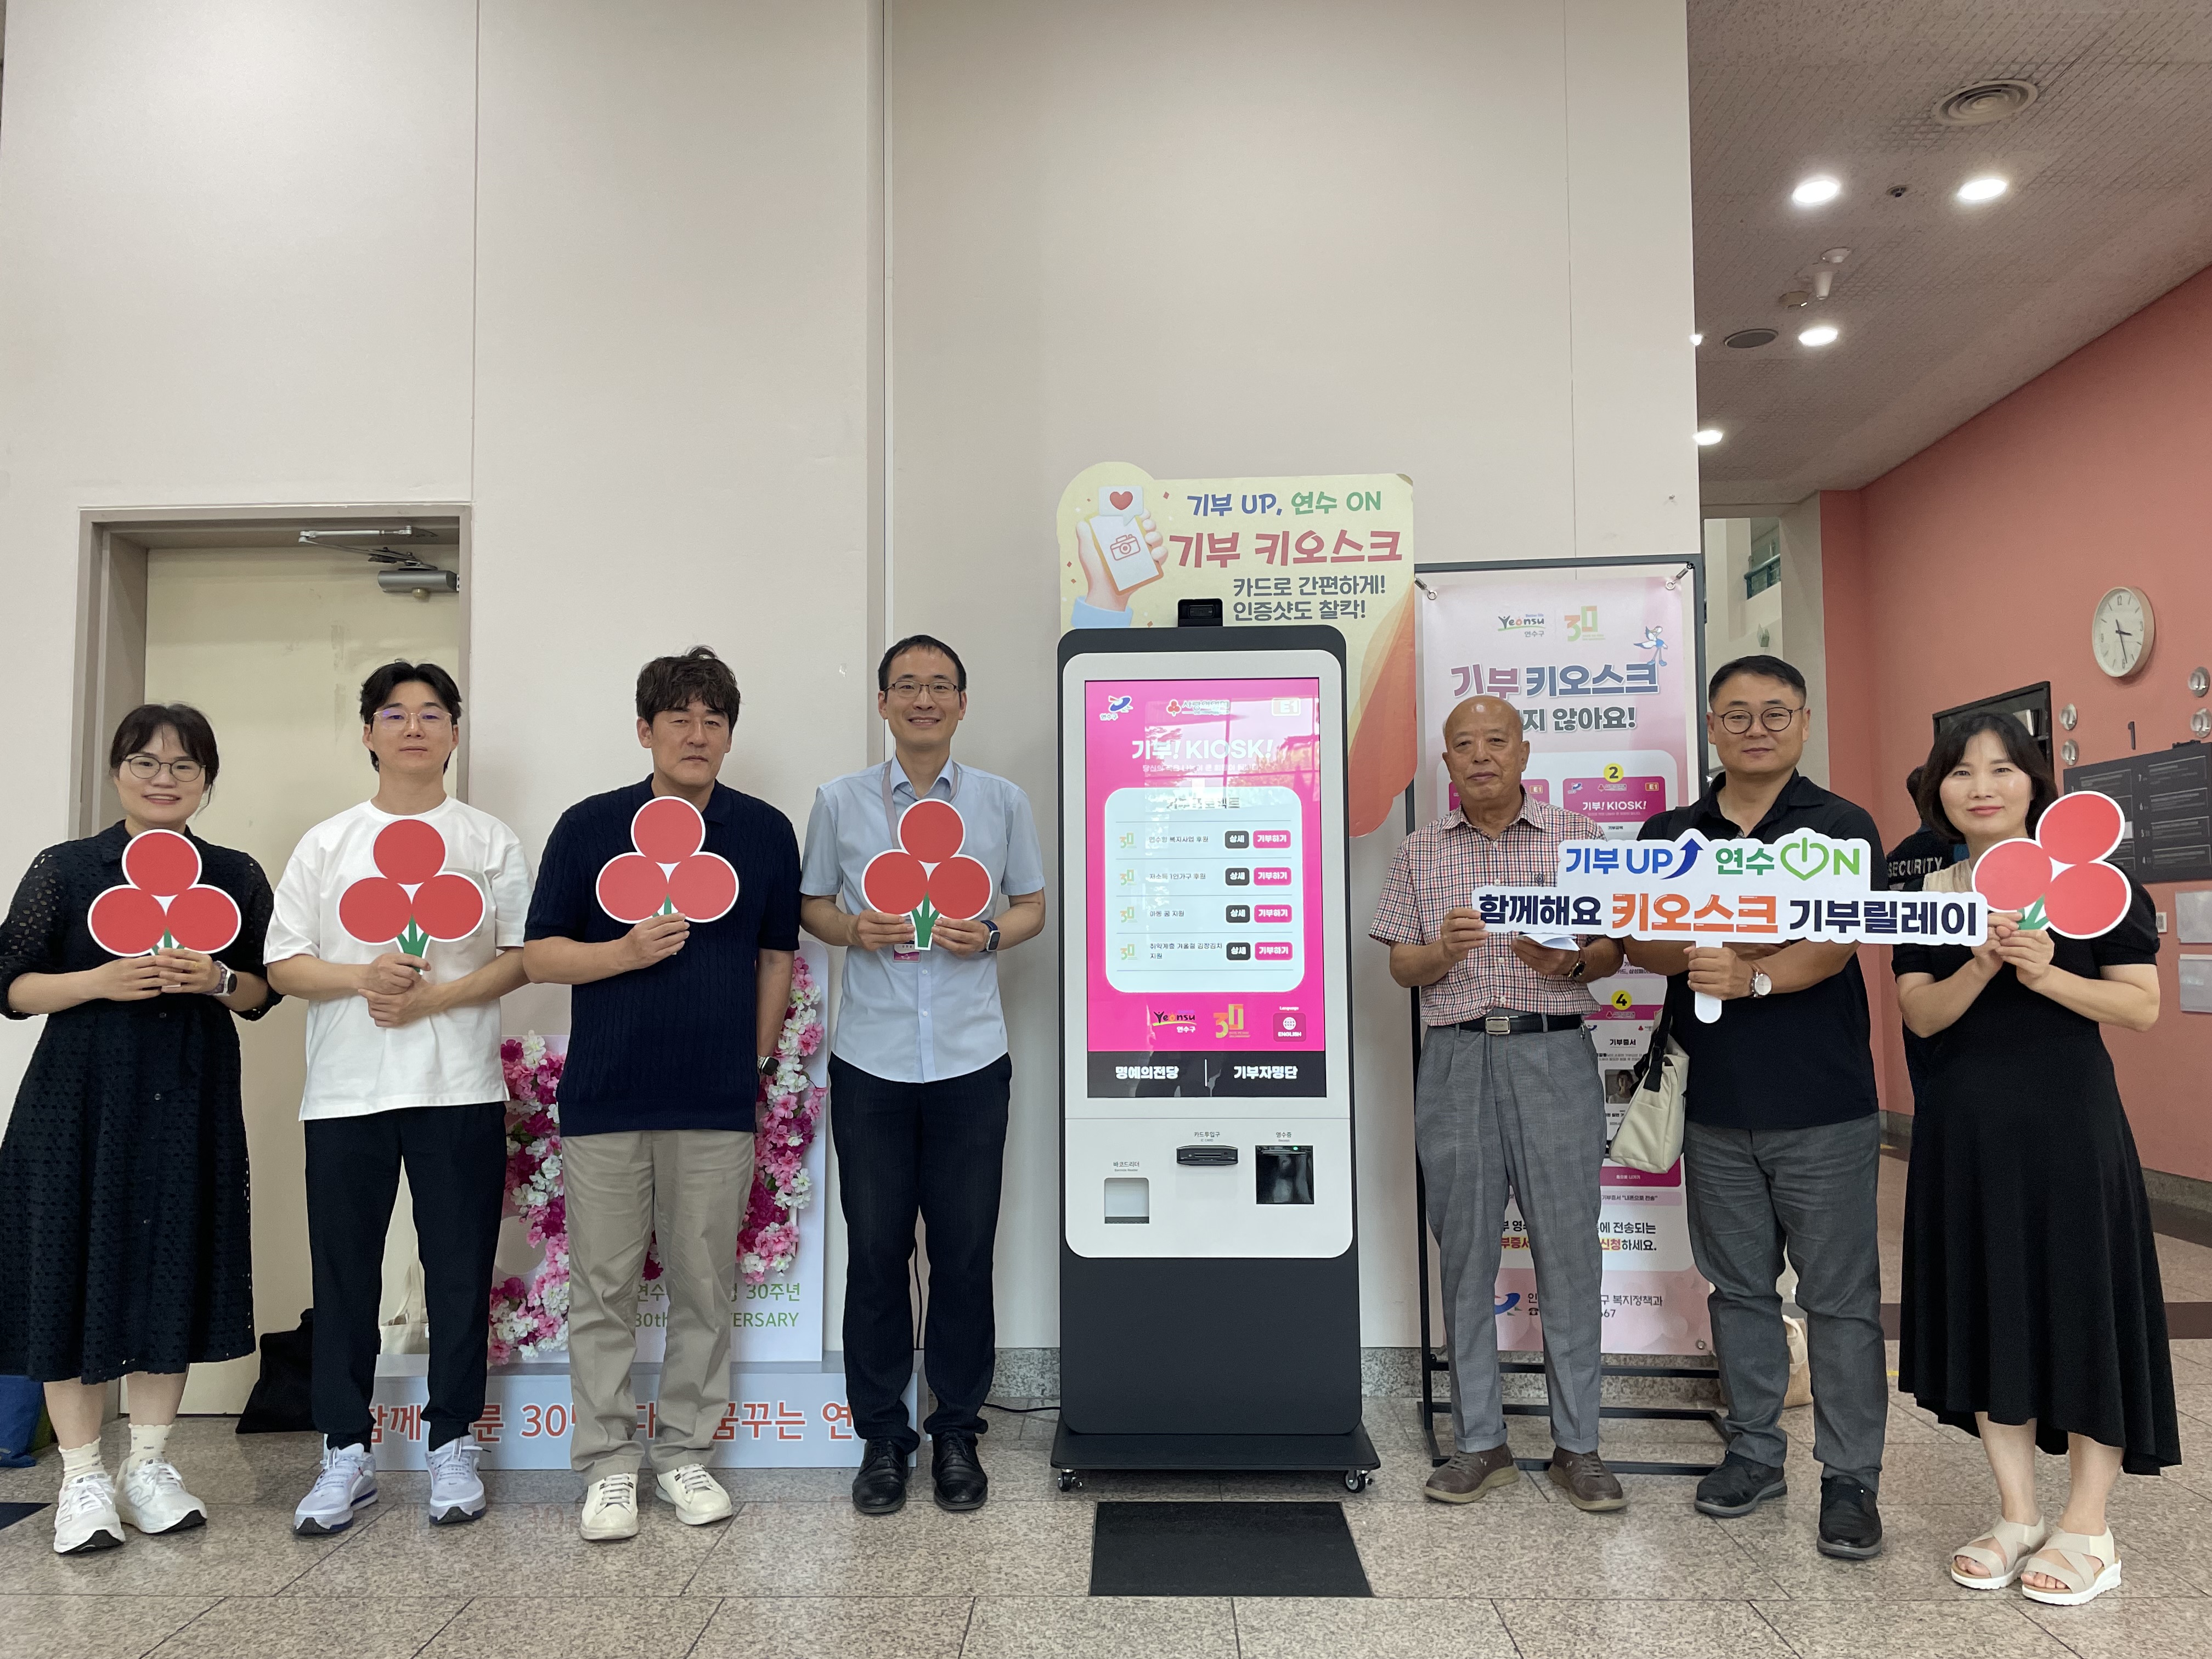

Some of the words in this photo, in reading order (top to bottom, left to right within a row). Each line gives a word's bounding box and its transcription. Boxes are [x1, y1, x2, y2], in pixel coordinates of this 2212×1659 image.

[1187, 494, 1232, 516] 기부
[1242, 494, 1283, 516] UP,
[1291, 491, 1338, 515] 연수
[1346, 490, 1381, 511] ON
[1169, 532, 1240, 568] 기부
[1255, 529, 1402, 566] 키오스크
[1233, 578, 1292, 597] 카드로
[1299, 575, 1386, 595] 간편하게!
[1233, 601, 1312, 621] 인증샷도
[1319, 600, 1365, 619] 찰칵!
[1498, 615, 1544, 629] Yeonsu
[1451, 664, 1519, 699] 기부
[1526, 663, 1659, 697] 키오스크
[1553, 706, 1637, 731] 않아요!
[1132, 740, 1182, 760] 기부!
[1186, 739, 1273, 759] KIOSK!
[1609, 766, 1619, 778] 2
[1582, 802, 1605, 810] 기부!
[1607, 801, 1647, 810] KIOSK!
[1229, 835, 1244, 843] 상세
[1257, 834, 1287, 843] 기부하기
[1566, 848, 1619, 874] 기부
[1626, 849, 1673, 874] UP
[1716, 848, 1775, 875] 연수
[1887, 856, 1942, 878] SECURITY
[1229, 872, 1245, 880] 상세
[1257, 871, 1288, 880] 기부하기
[1230, 909, 1245, 917] 상세
[1258, 909, 1288, 917] 기부하기
[1479, 894, 1601, 926] 함께해요
[1612, 893, 1778, 933] 키오스크
[1790, 899, 1976, 936] 기부릴레이
[1231, 946, 1246, 955] 상세
[1259, 946, 1289, 955] 기부하기
[1616, 994, 1628, 1006] 4
[1153, 1011, 1195, 1024] Yeonsu
[1115, 1066, 1179, 1080] 명예의전당
[1234, 1066, 1298, 1080] 기부자명단
[1613, 1222, 1656, 1234] 전송되는
[1601, 1239, 1657, 1251] 신청하세요.
[746, 1283, 800, 1302] 30주년
[1613, 1295, 1663, 1306] 복지정책과
[731, 1312, 799, 1328] ERSARY
[521, 1404, 575, 1438] 30
[823, 1401, 853, 1440] 연
